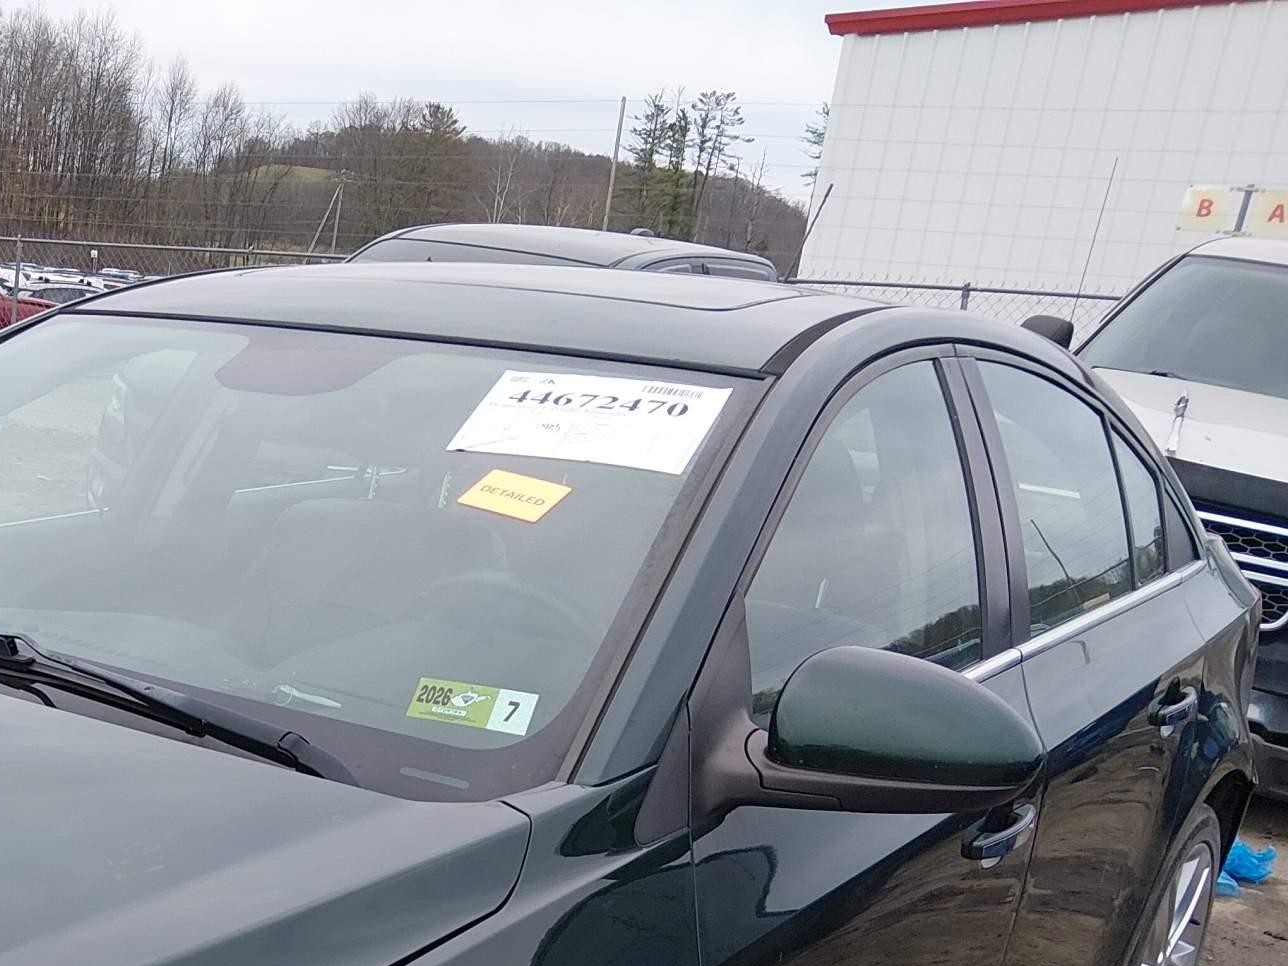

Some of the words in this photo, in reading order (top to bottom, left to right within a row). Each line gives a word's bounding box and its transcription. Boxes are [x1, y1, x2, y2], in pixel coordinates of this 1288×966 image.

[1196, 199, 1214, 217] B
[1267, 204, 1285, 223] A
[508, 389, 690, 418] 44672470
[479, 484, 546, 506] DETAILED
[416, 685, 453, 705] 2026
[503, 701, 520, 722] 7
